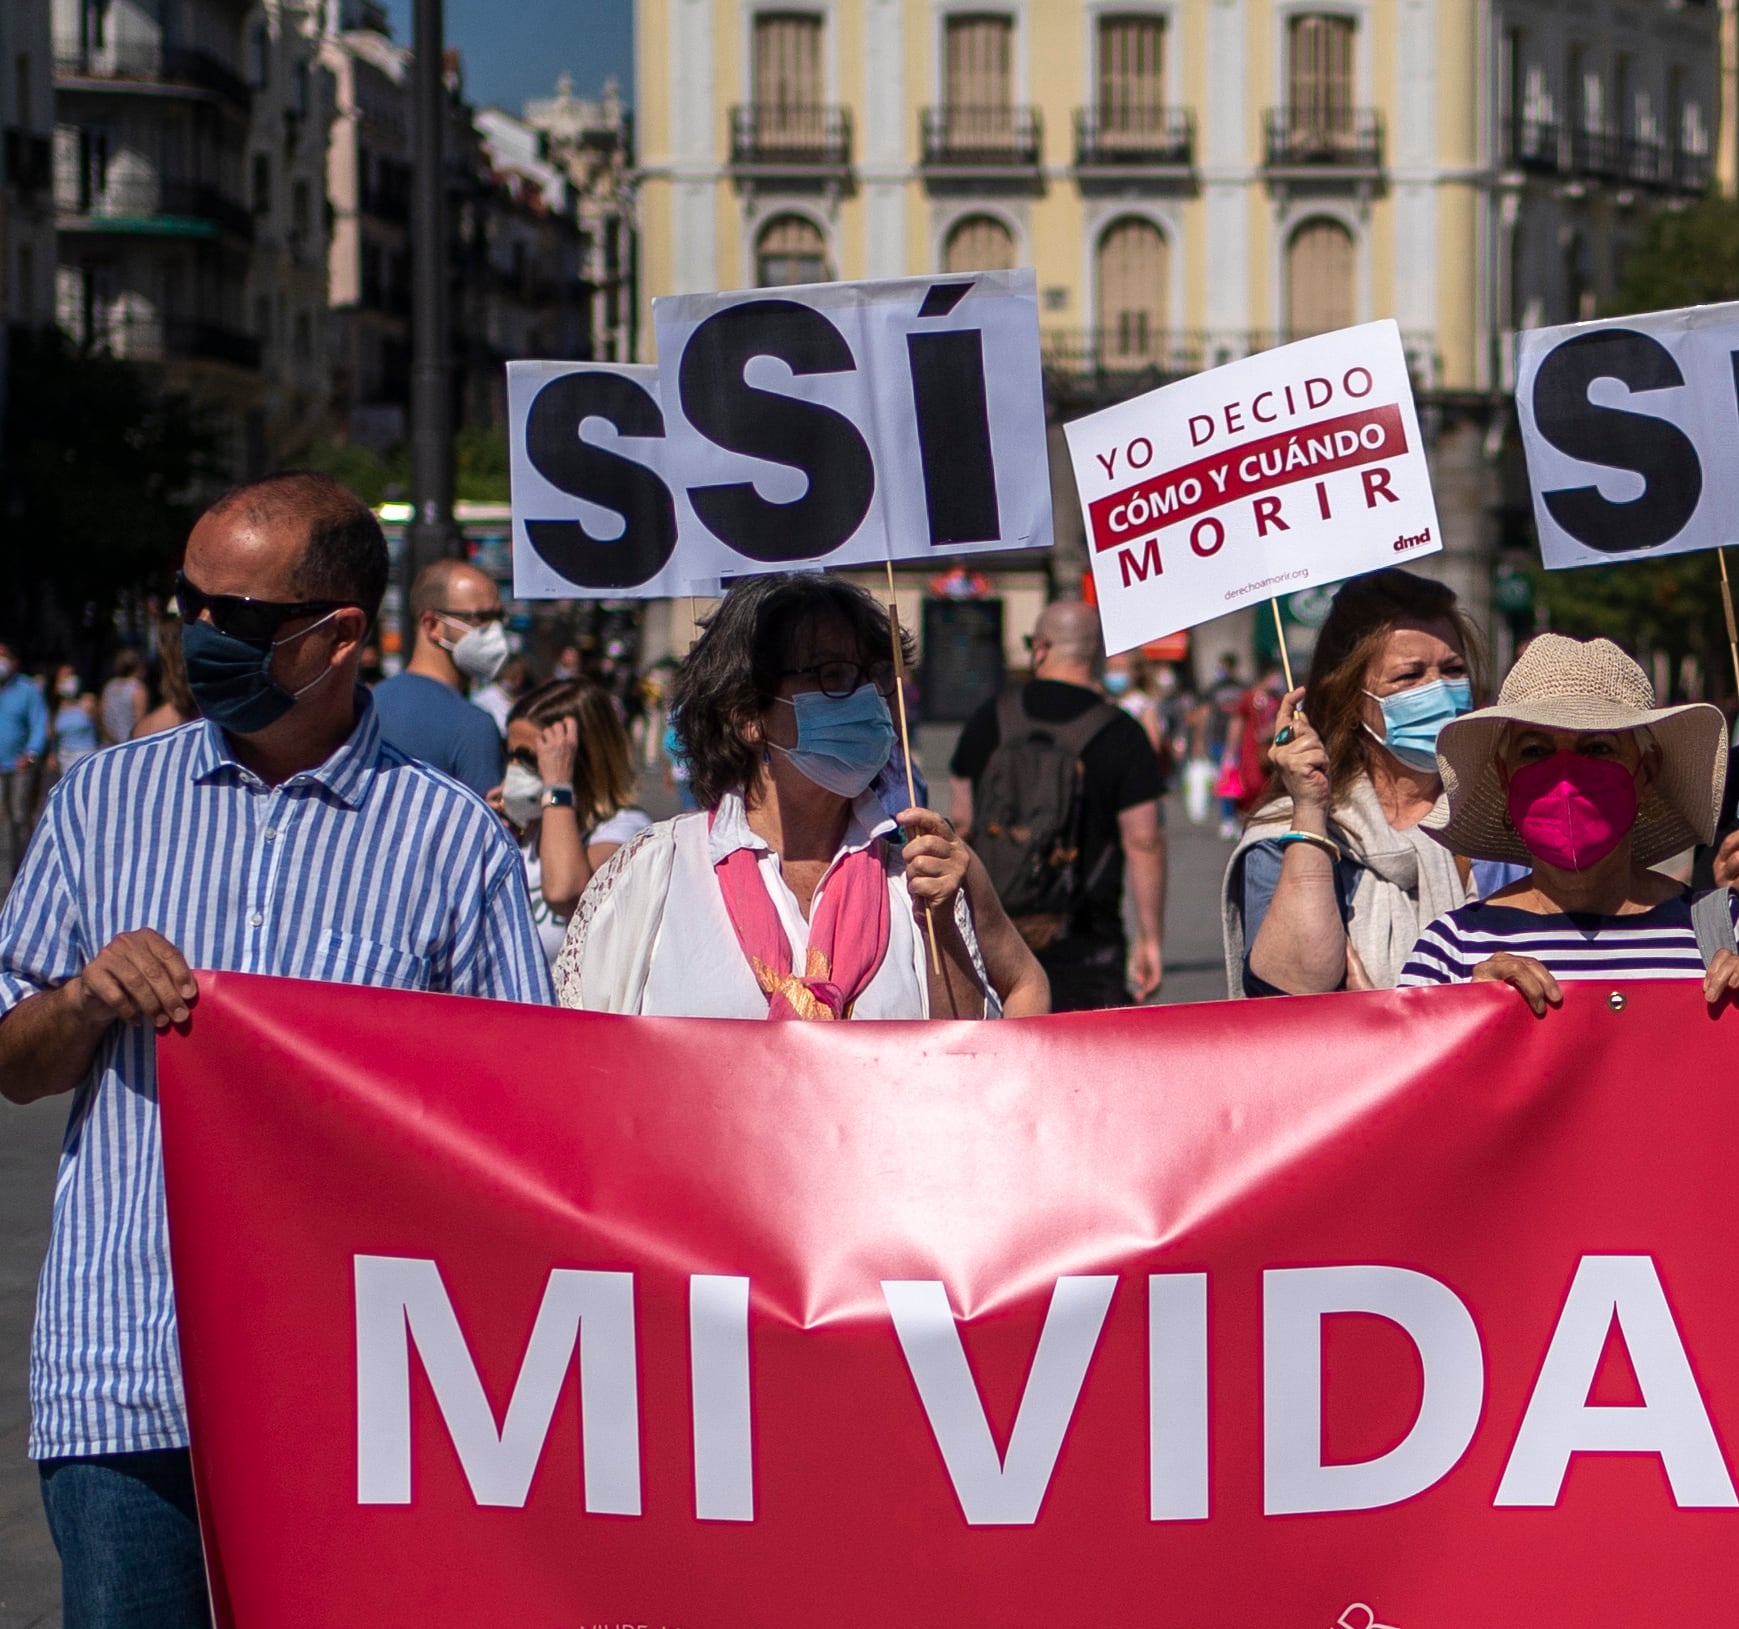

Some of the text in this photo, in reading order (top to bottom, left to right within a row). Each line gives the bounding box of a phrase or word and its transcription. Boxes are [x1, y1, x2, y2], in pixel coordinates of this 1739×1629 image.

[524, 372, 679, 590] S
[679, 283, 1001, 562] SÍ
[1096, 367, 1373, 480] YO DECIDO
[1108, 423, 1386, 533] CÓMO Y CUÁNDO
[1118, 467, 1400, 588] MORIR
[1224, 568, 1309, 600] derechoamorir.org
[1393, 527, 1431, 552] dmd
[354, 1254, 754, 1522] MI
[880, 1255, 1739, 1526] VIDA
